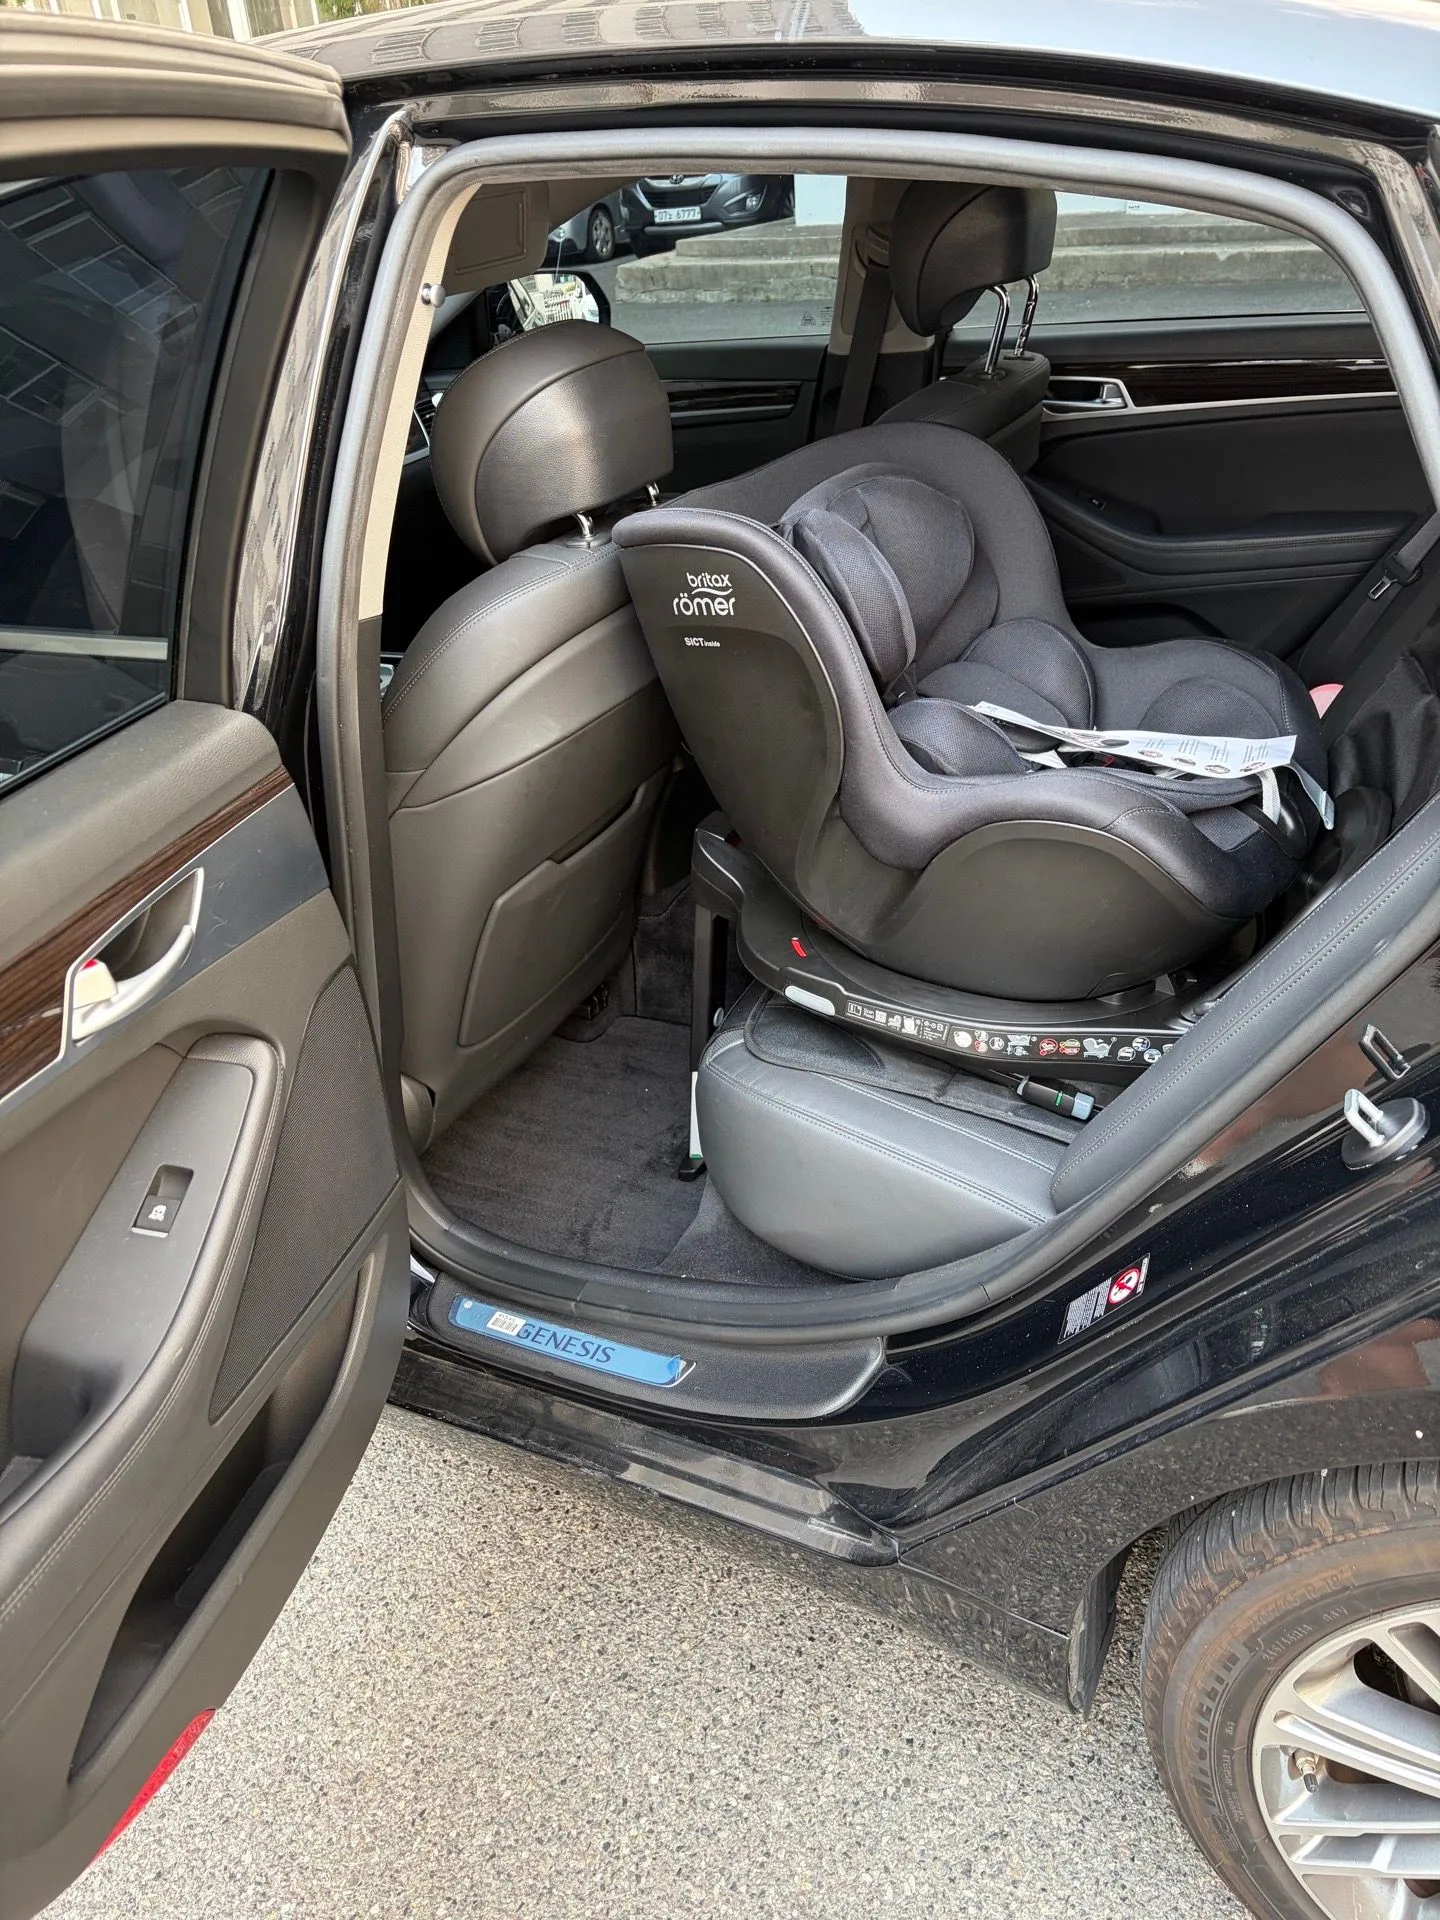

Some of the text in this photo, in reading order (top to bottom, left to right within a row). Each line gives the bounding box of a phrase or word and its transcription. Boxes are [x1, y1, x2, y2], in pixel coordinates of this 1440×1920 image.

[686, 572, 732, 587] britax
[672, 592, 736, 616] römer
[684, 637, 704, 647] SICT
[516, 1323, 616, 1363] GENESIS
